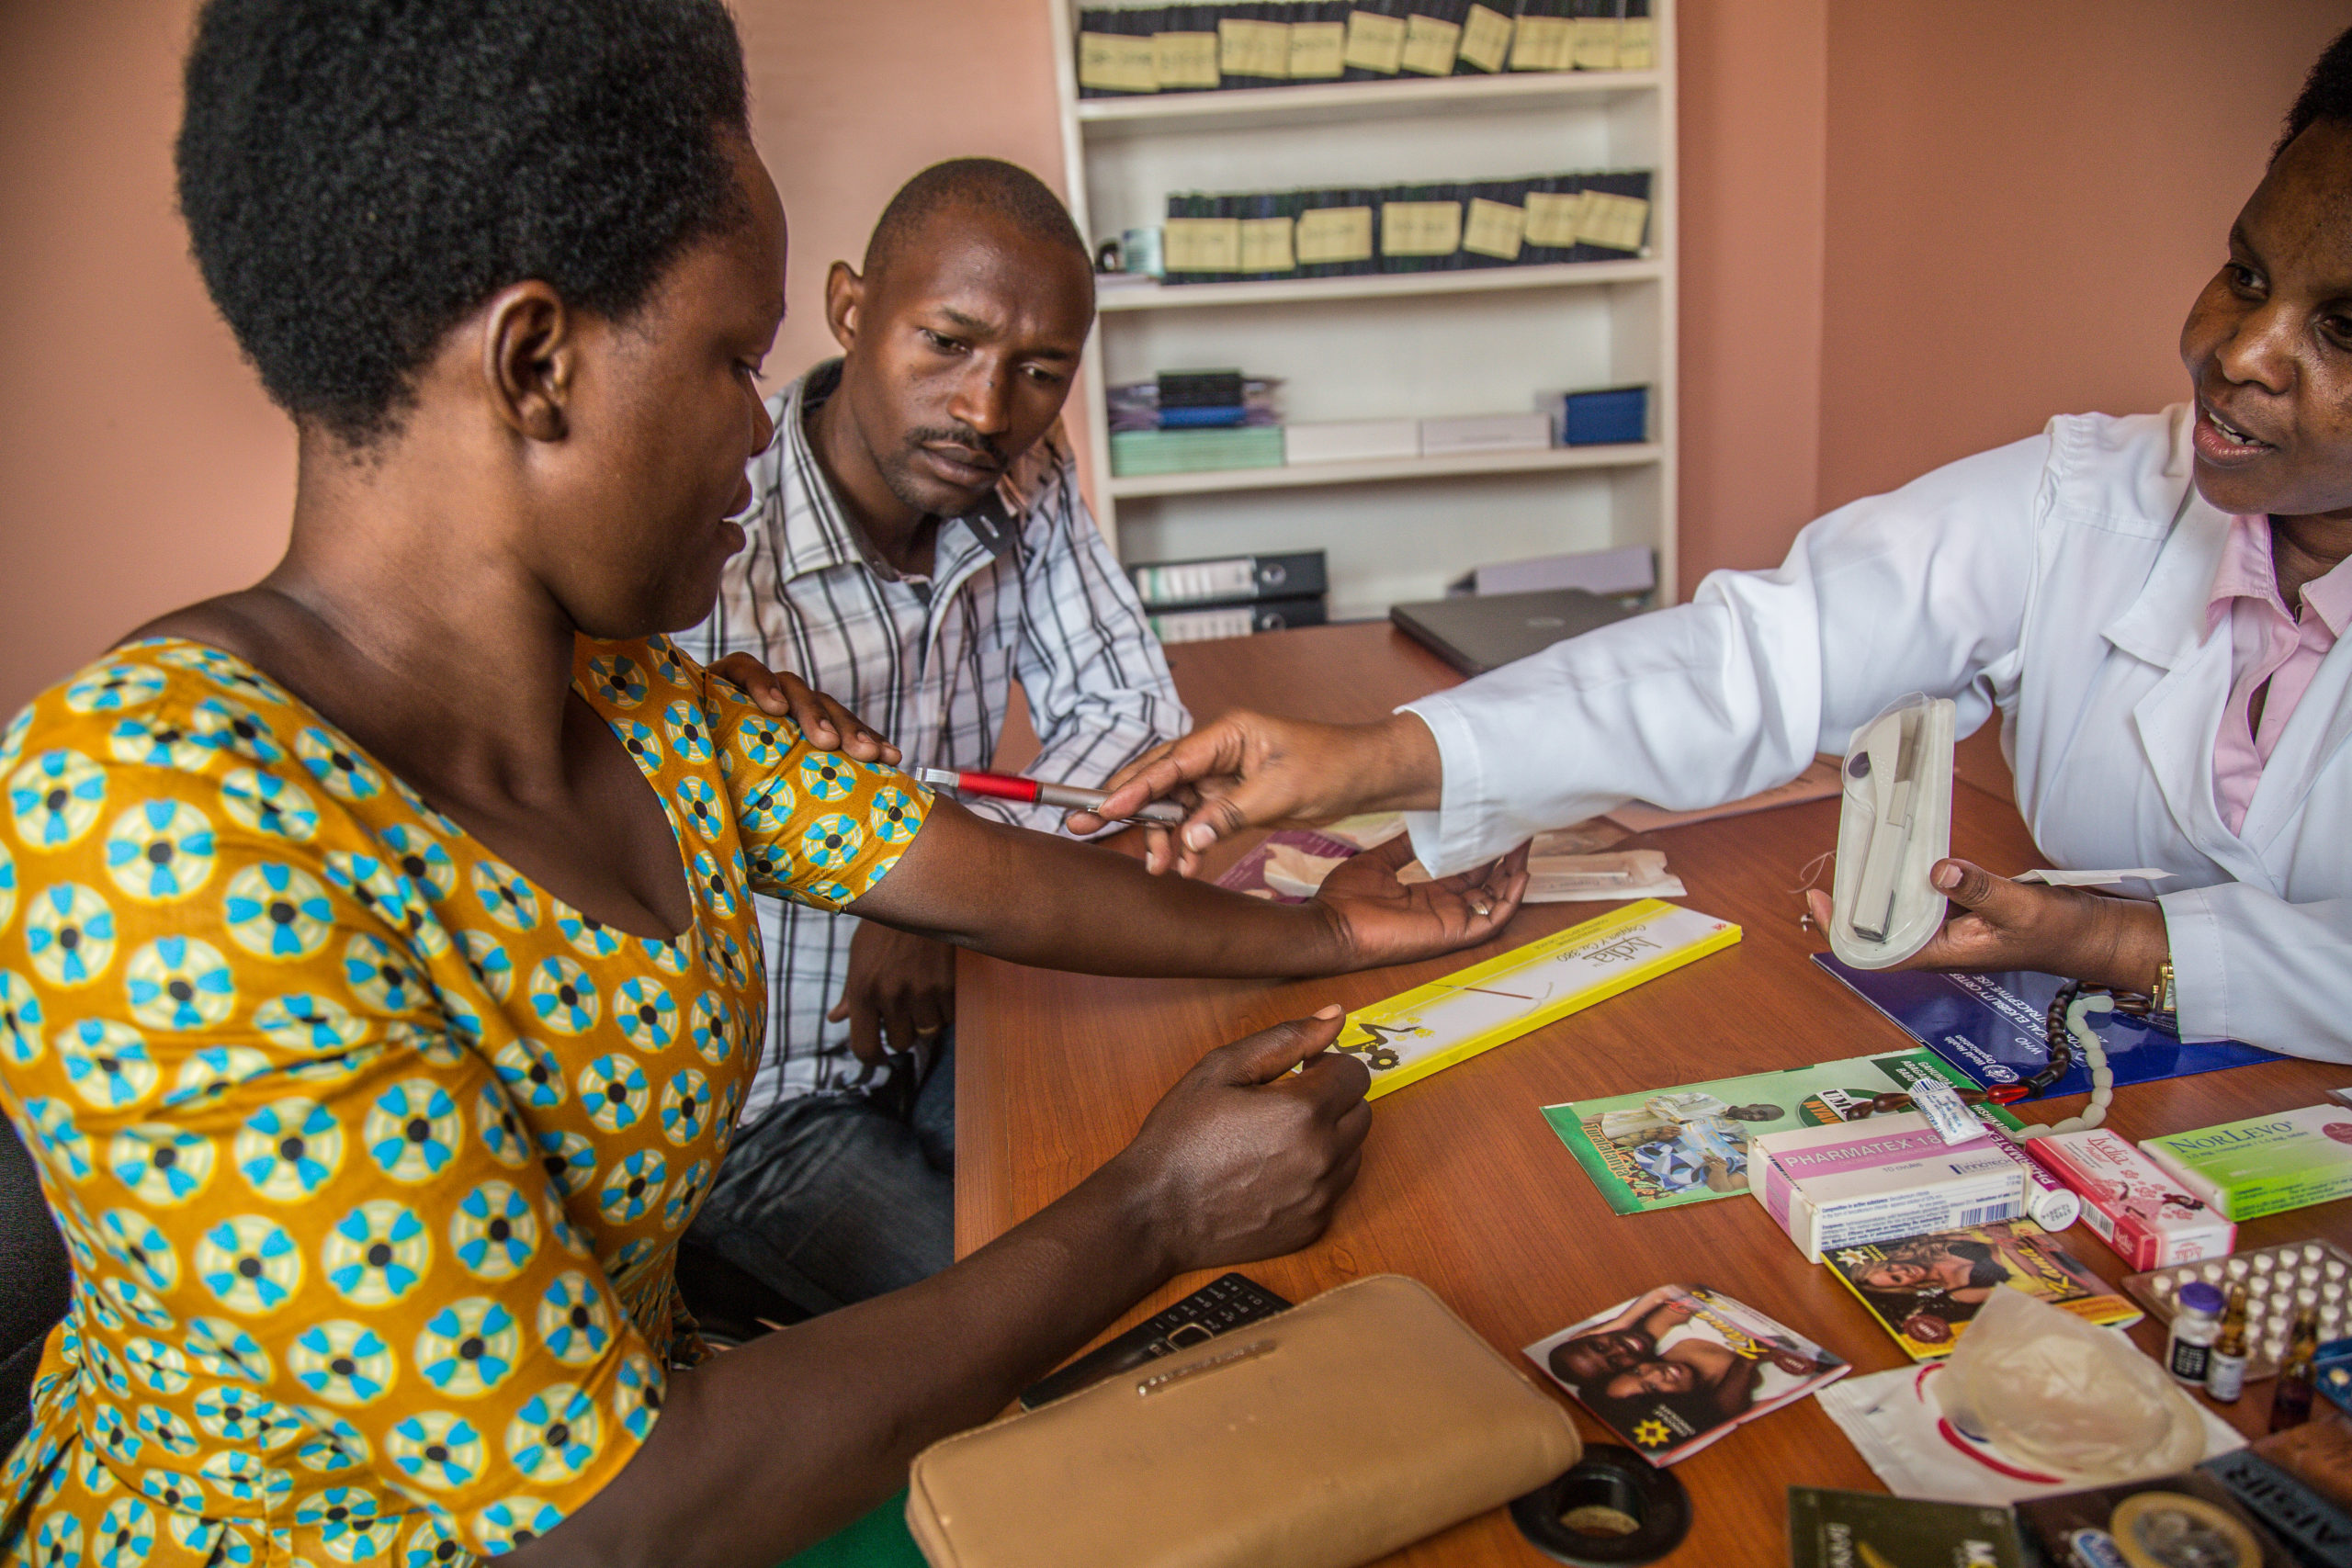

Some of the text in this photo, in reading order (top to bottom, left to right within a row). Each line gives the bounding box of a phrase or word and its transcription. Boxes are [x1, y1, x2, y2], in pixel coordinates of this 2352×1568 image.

[1556, 949, 1582, 963] 380
[1973, 974, 1996, 987] USE
[1980, 989, 2032, 1024] ELIGIBILITY
[1943, 1035, 1986, 1066] World Health
[1954, 1034, 1997, 1064] Organization
[2014, 1036, 2043, 1055] WHO
[1580, 1122, 1632, 1179] Turafatanya
[1783, 1137, 1912, 1168] PHARMATEX
[1883, 1161, 1924, 1174] 10 ovules
